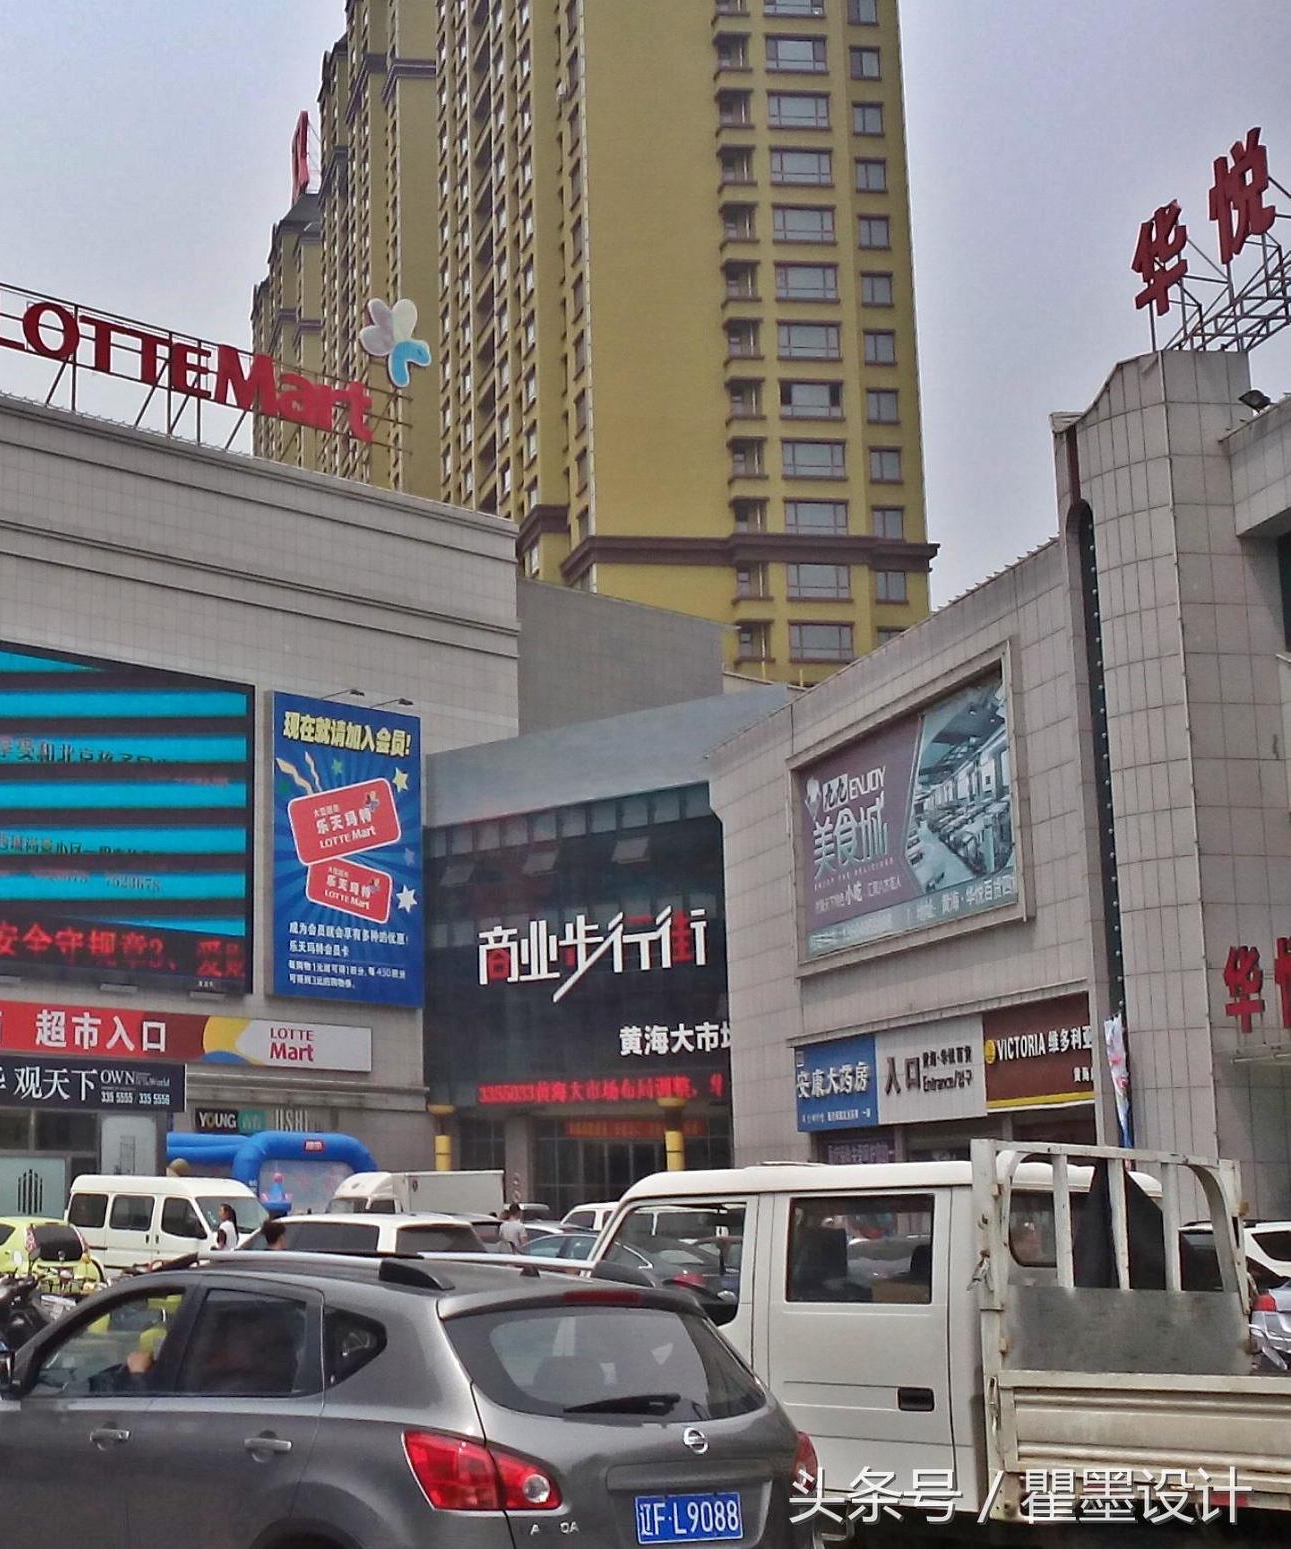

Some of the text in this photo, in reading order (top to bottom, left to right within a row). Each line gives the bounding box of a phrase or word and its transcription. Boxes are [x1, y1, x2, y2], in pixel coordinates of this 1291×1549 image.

[1131, 127, 1276, 316] 华悦
[849, 766, 886, 800] ENJOY
[813, 791, 888, 880] 美食城
[478, 905, 707, 1004] 商业步行街
[35, 1008, 167, 1054] 超市入口
[270, 1027, 314, 1041] LOTTE
[997, 1033, 1045, 1062] VICTORIA
[270, 1042, 315, 1062] Mart
[13, 1067, 98, 1102] 观天下
[100, 1069, 135, 1085] OWN
[884, 1056, 922, 1096] 入口
[199, 1111, 237, 1129] YOUNG
